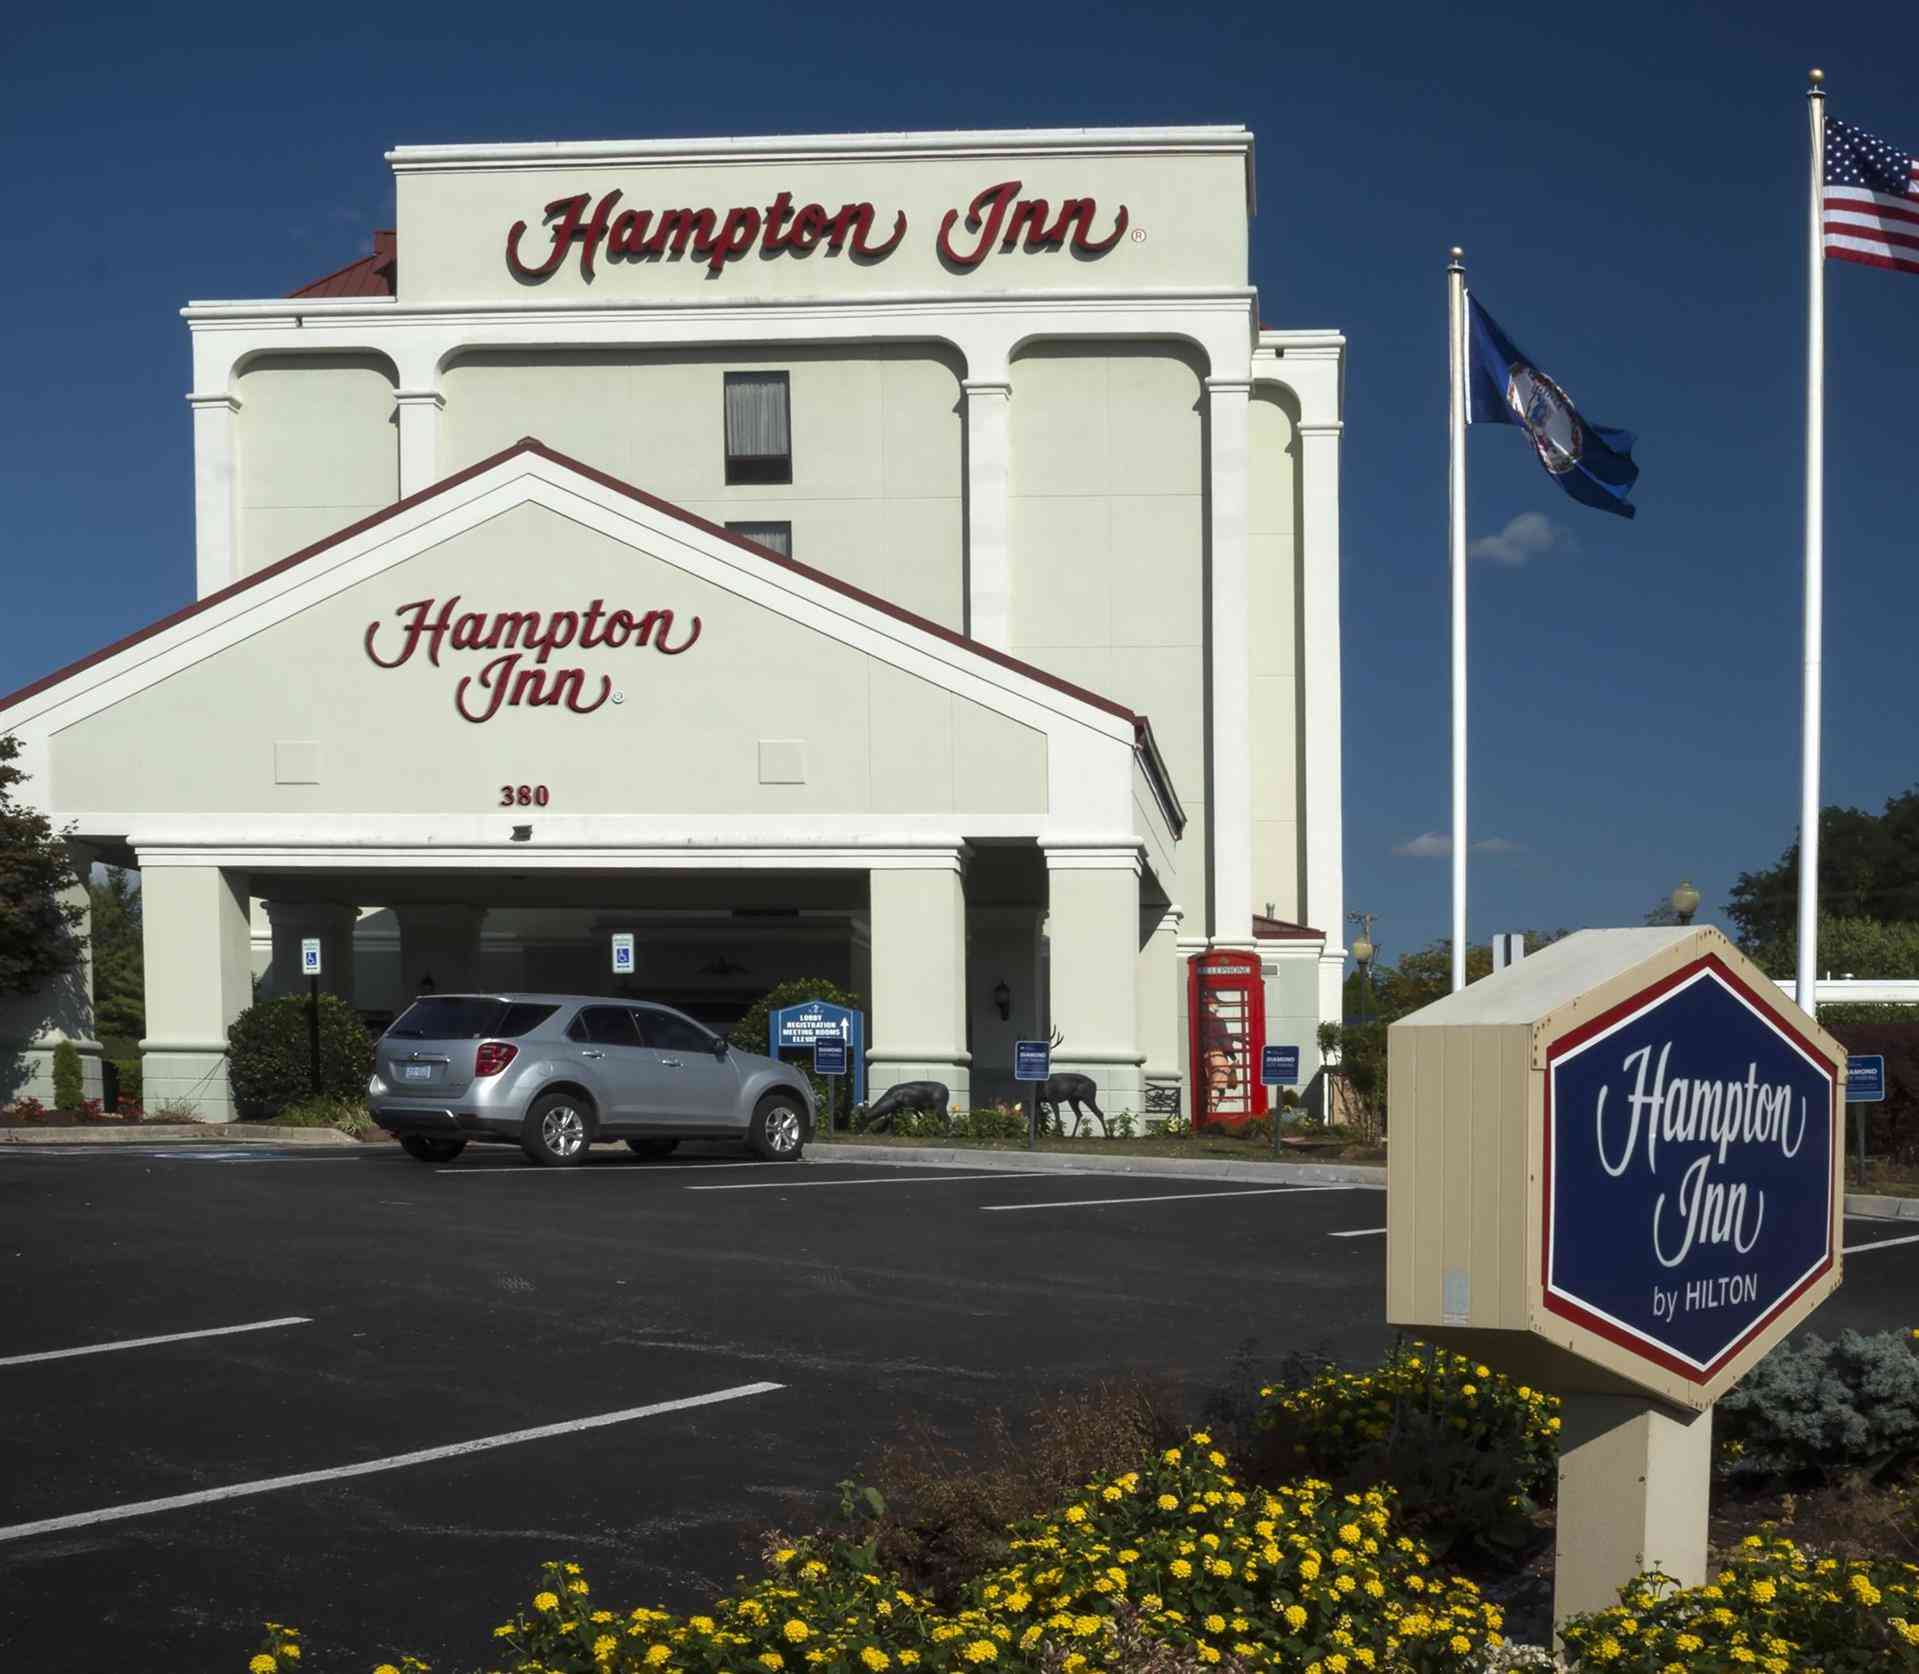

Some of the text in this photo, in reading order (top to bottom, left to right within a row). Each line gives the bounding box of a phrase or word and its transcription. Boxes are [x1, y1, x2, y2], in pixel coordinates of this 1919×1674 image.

[507, 180, 1129, 284] Hampton Inn
[365, 596, 702, 668] Hampton
[456, 653, 611, 723] Inn
[499, 784, 549, 807] 380
[1596, 1041, 1806, 1177] Hampton
[1654, 1154, 1764, 1268] Inn
[1653, 1273, 1758, 1323] by HILTON
